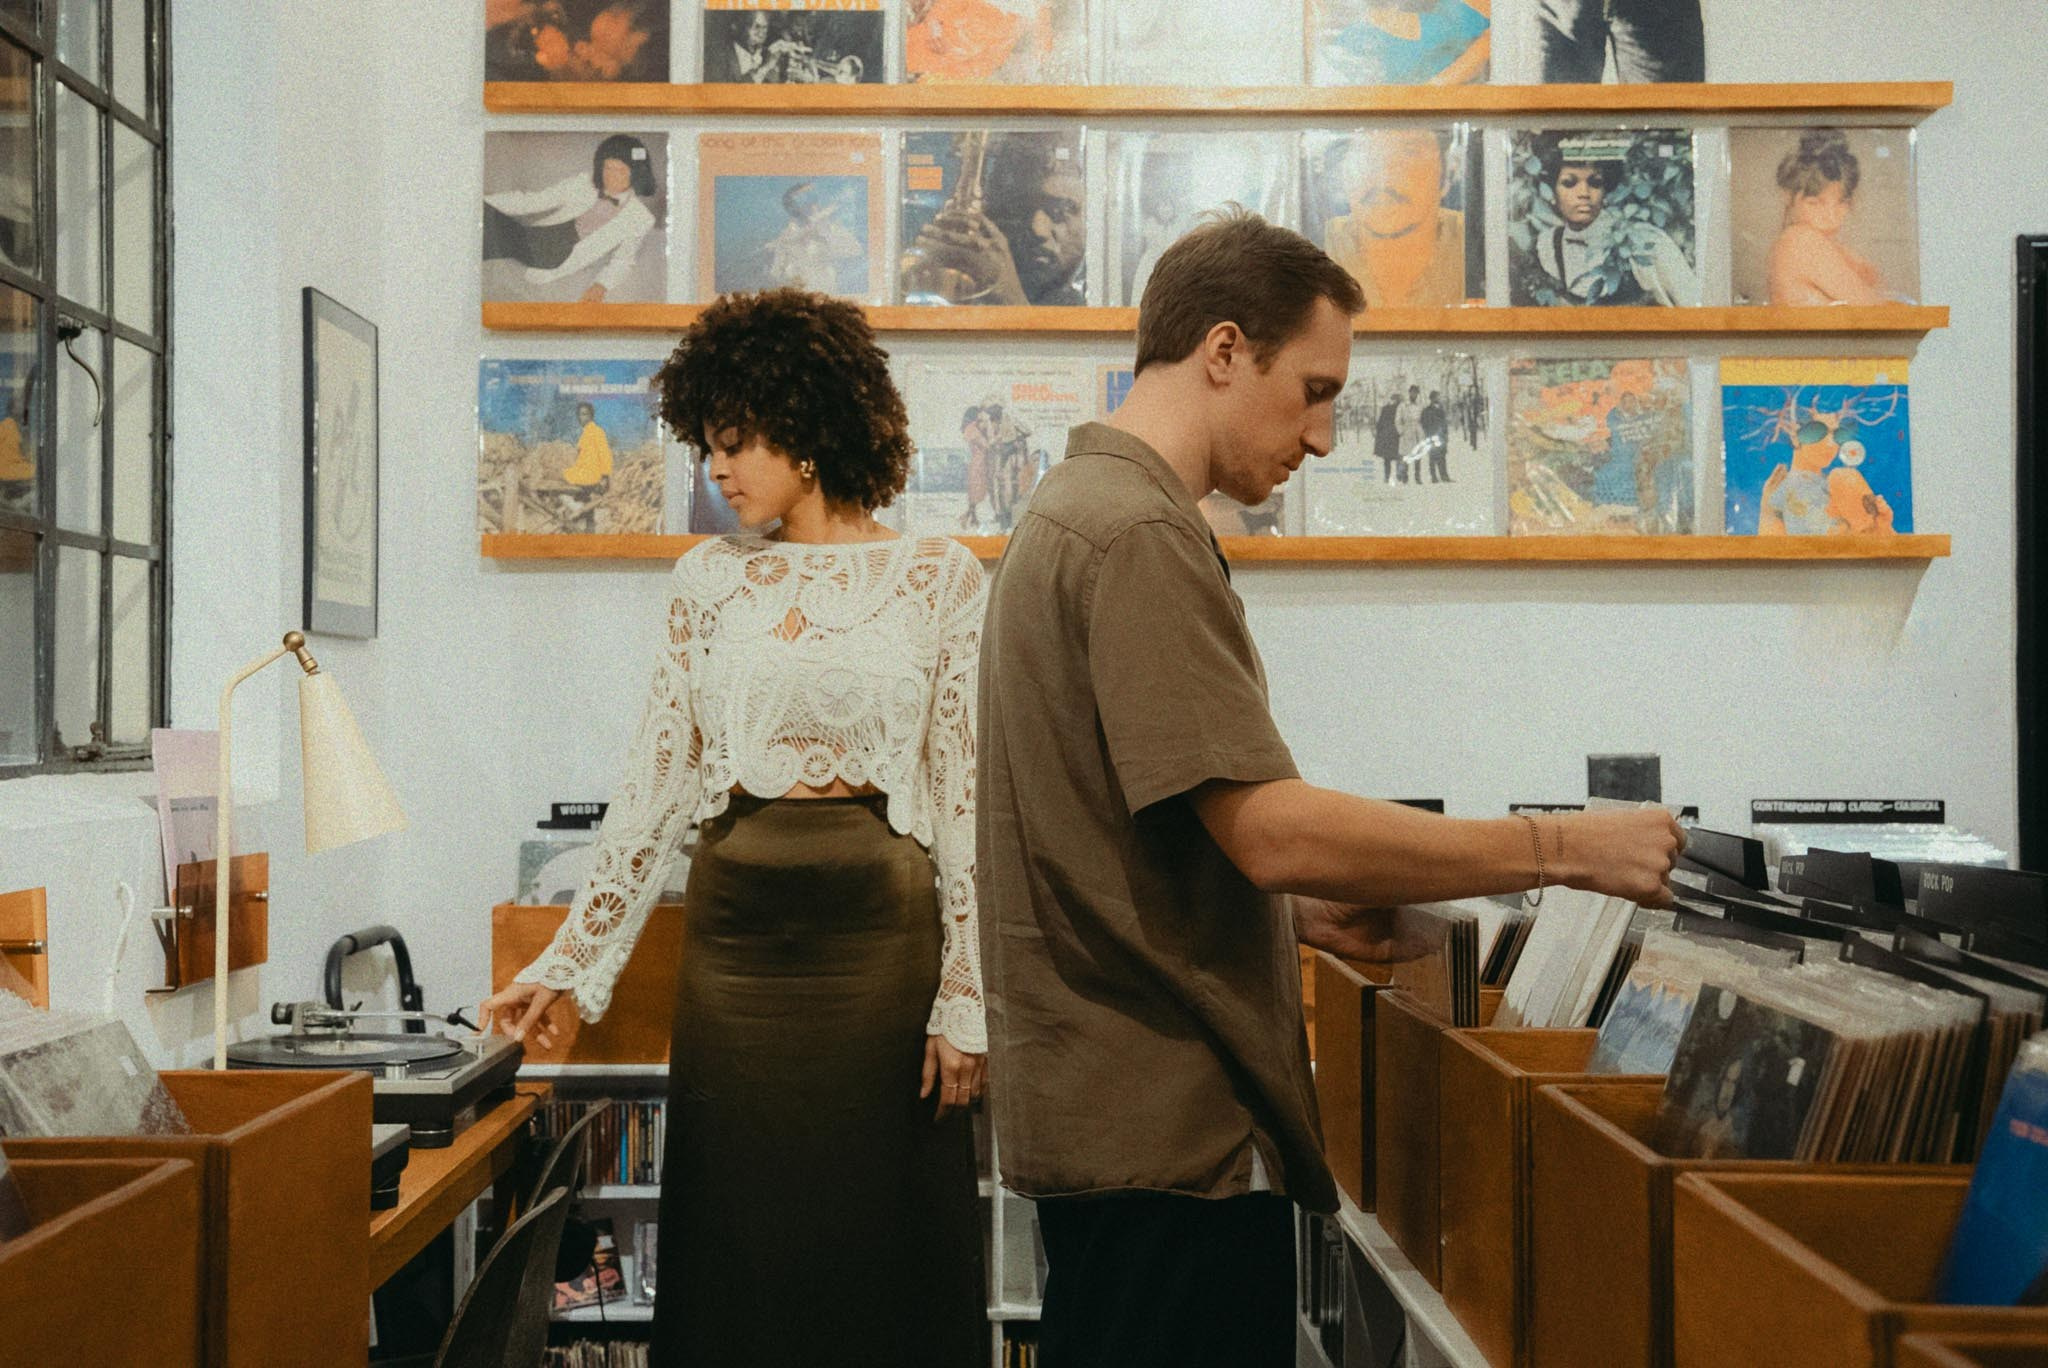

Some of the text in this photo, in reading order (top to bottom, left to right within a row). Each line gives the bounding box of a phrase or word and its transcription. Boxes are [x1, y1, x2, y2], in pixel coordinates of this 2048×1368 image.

[560, 804, 599, 816] WORDS
[1753, 801, 1828, 813] CONTEMPORARY
[1923, 872, 1953, 894] ROCK POP
